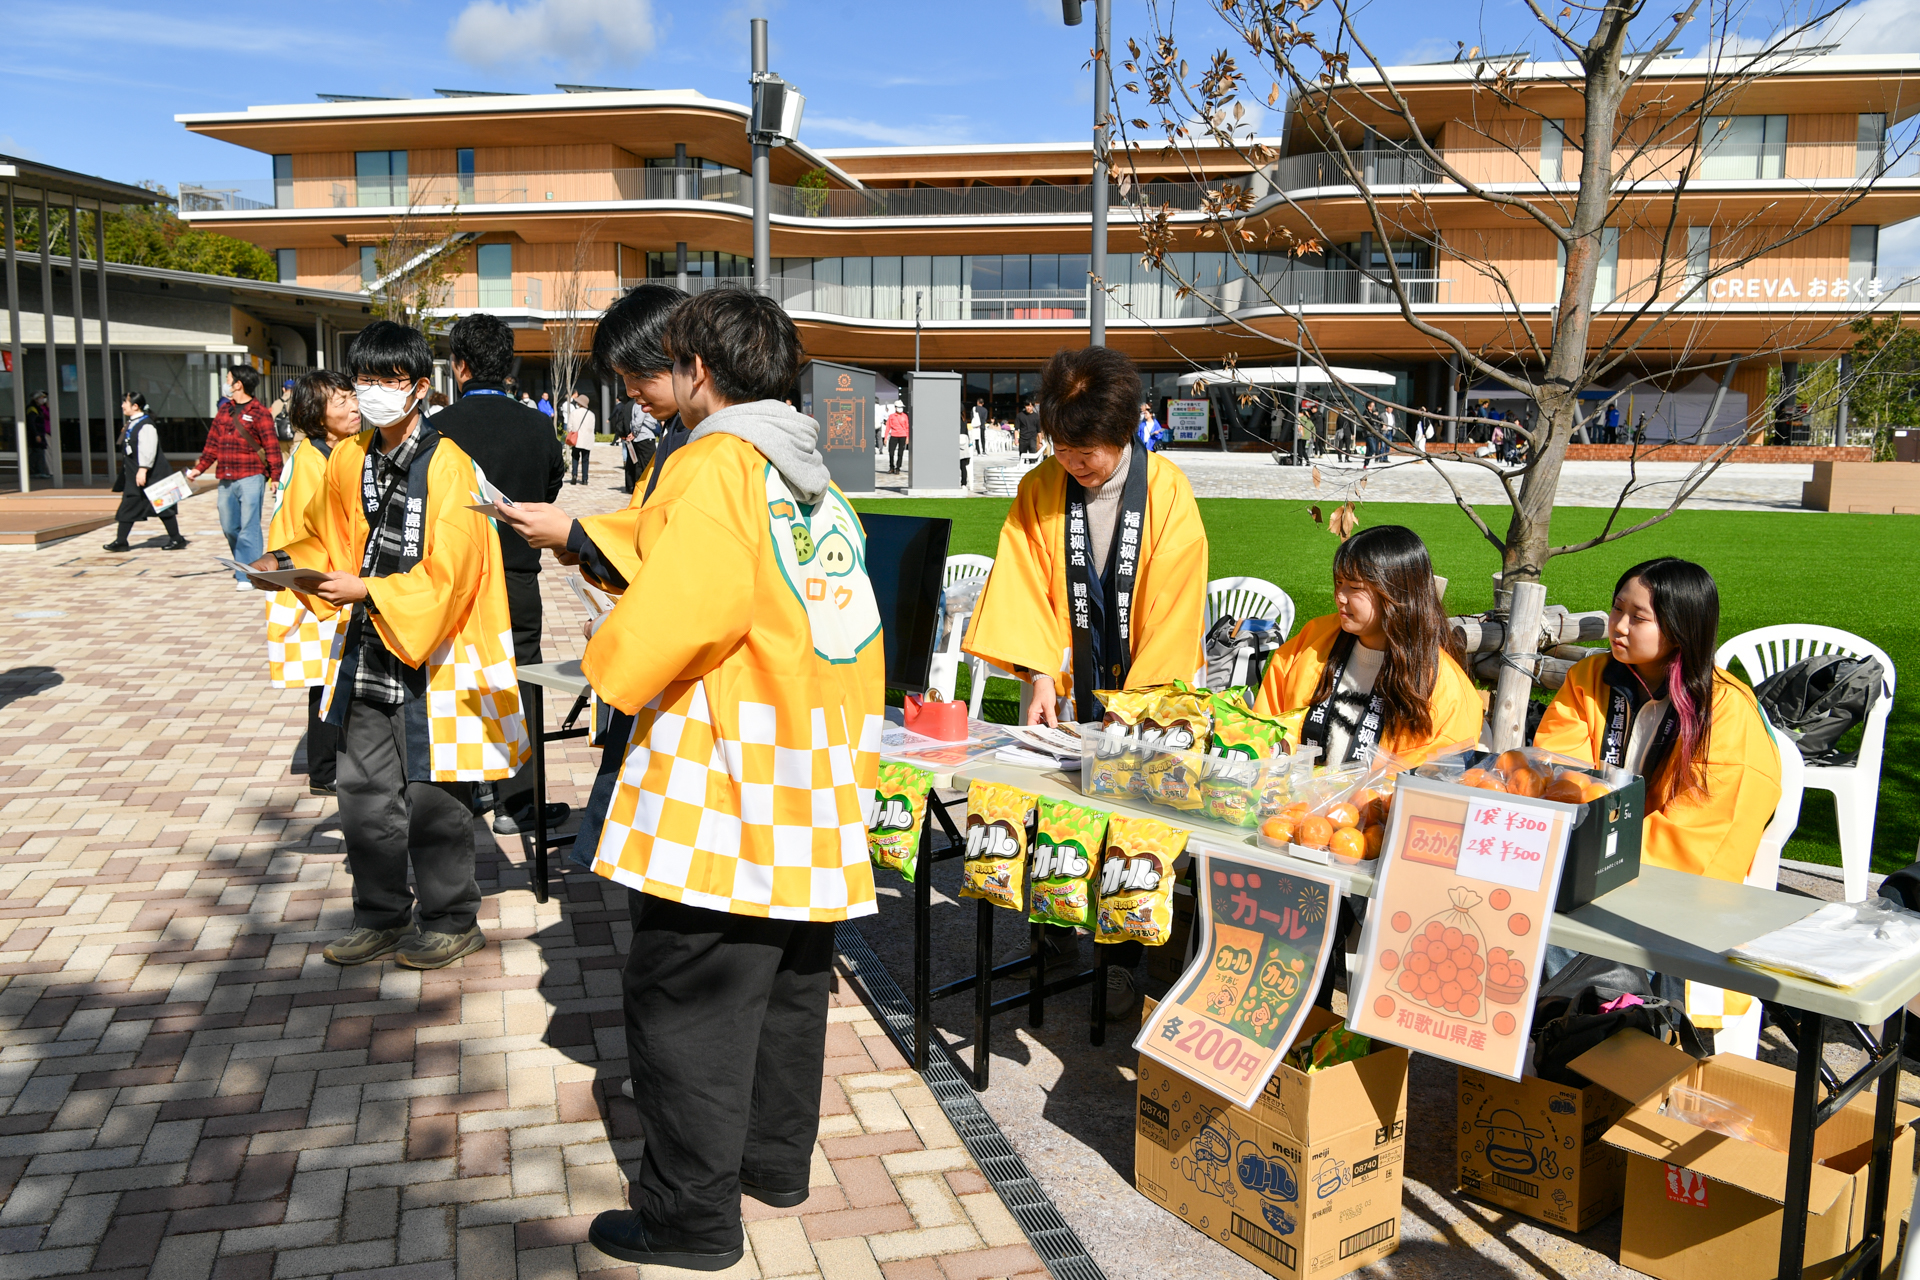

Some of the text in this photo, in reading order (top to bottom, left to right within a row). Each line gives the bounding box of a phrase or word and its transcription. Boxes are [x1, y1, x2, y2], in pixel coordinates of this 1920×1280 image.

[1711, 276, 1884, 298] CREVA おおくま
[403, 497, 422, 557] 福島拠点
[1069, 502, 1089, 629] 福島拠点 観光班
[1117, 510, 1141, 639] 福島拠点 観光班
[1352, 695, 1384, 760] 福島拠点
[1474, 807, 1547, 832] 1袋 ¥300
[965, 823, 1020, 860] カール
[1411, 829, 1459, 859] みかん
[1466, 836, 1541, 862] 2袋 ¥500
[1031, 844, 1089, 880] カール
[1100, 855, 1161, 898] カール
[1230, 890, 1308, 940] カール
[1129, 928, 1156, 938] うすあじ
[1217, 949, 1251, 972] カール
[1214, 973, 1240, 986] うすあじ
[1262, 964, 1296, 996] カール
[1260, 990, 1281, 1007] チーズ
[1396, 1008, 1487, 1051] 和歌山県産
[1160, 1016, 1262, 1083] 各200円
[1559, 1090, 1577, 1100] meiji
[1140, 1100, 1169, 1124] 08740
[1272, 1141, 1302, 1163] meiji
[1311, 1147, 1330, 1161] meiji
[1353, 1159, 1377, 1175] 08740
[1237, 1154, 1298, 1201] カール
